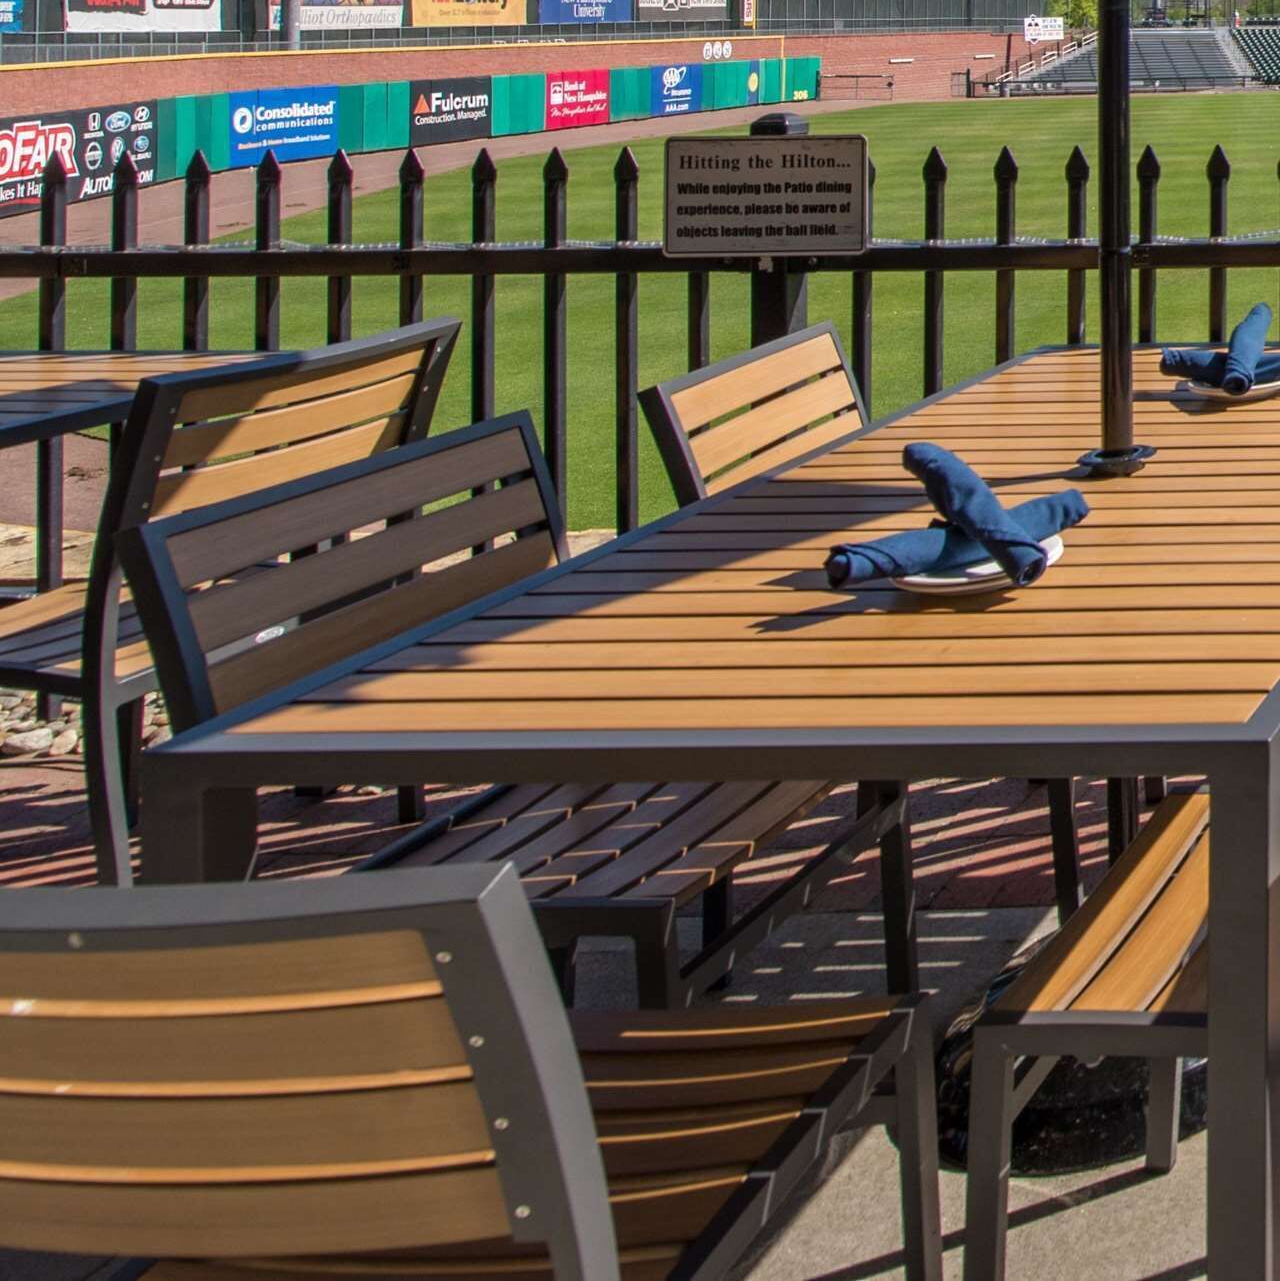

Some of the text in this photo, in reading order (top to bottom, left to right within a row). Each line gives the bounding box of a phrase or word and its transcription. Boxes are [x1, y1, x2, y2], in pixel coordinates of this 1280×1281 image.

[573, 4, 606, 20] University
[564, 80, 578, 92] Bank
[431, 91, 489, 113] Fulcrum
[564, 89, 608, 104] New Hampshire
[256, 101, 333, 121] Consolidated
[415, 109, 487, 126] Construction. Managed.
[256, 117, 334, 132] communications
[679, 153, 852, 171] Hitting the Hilton...
[17, 183, 25, 198] It
[677, 181, 852, 195] While enjoying the Patio dining
[676, 201, 852, 216] experience, please be aware of
[676, 223, 839, 238] objects leaving the ball field.
